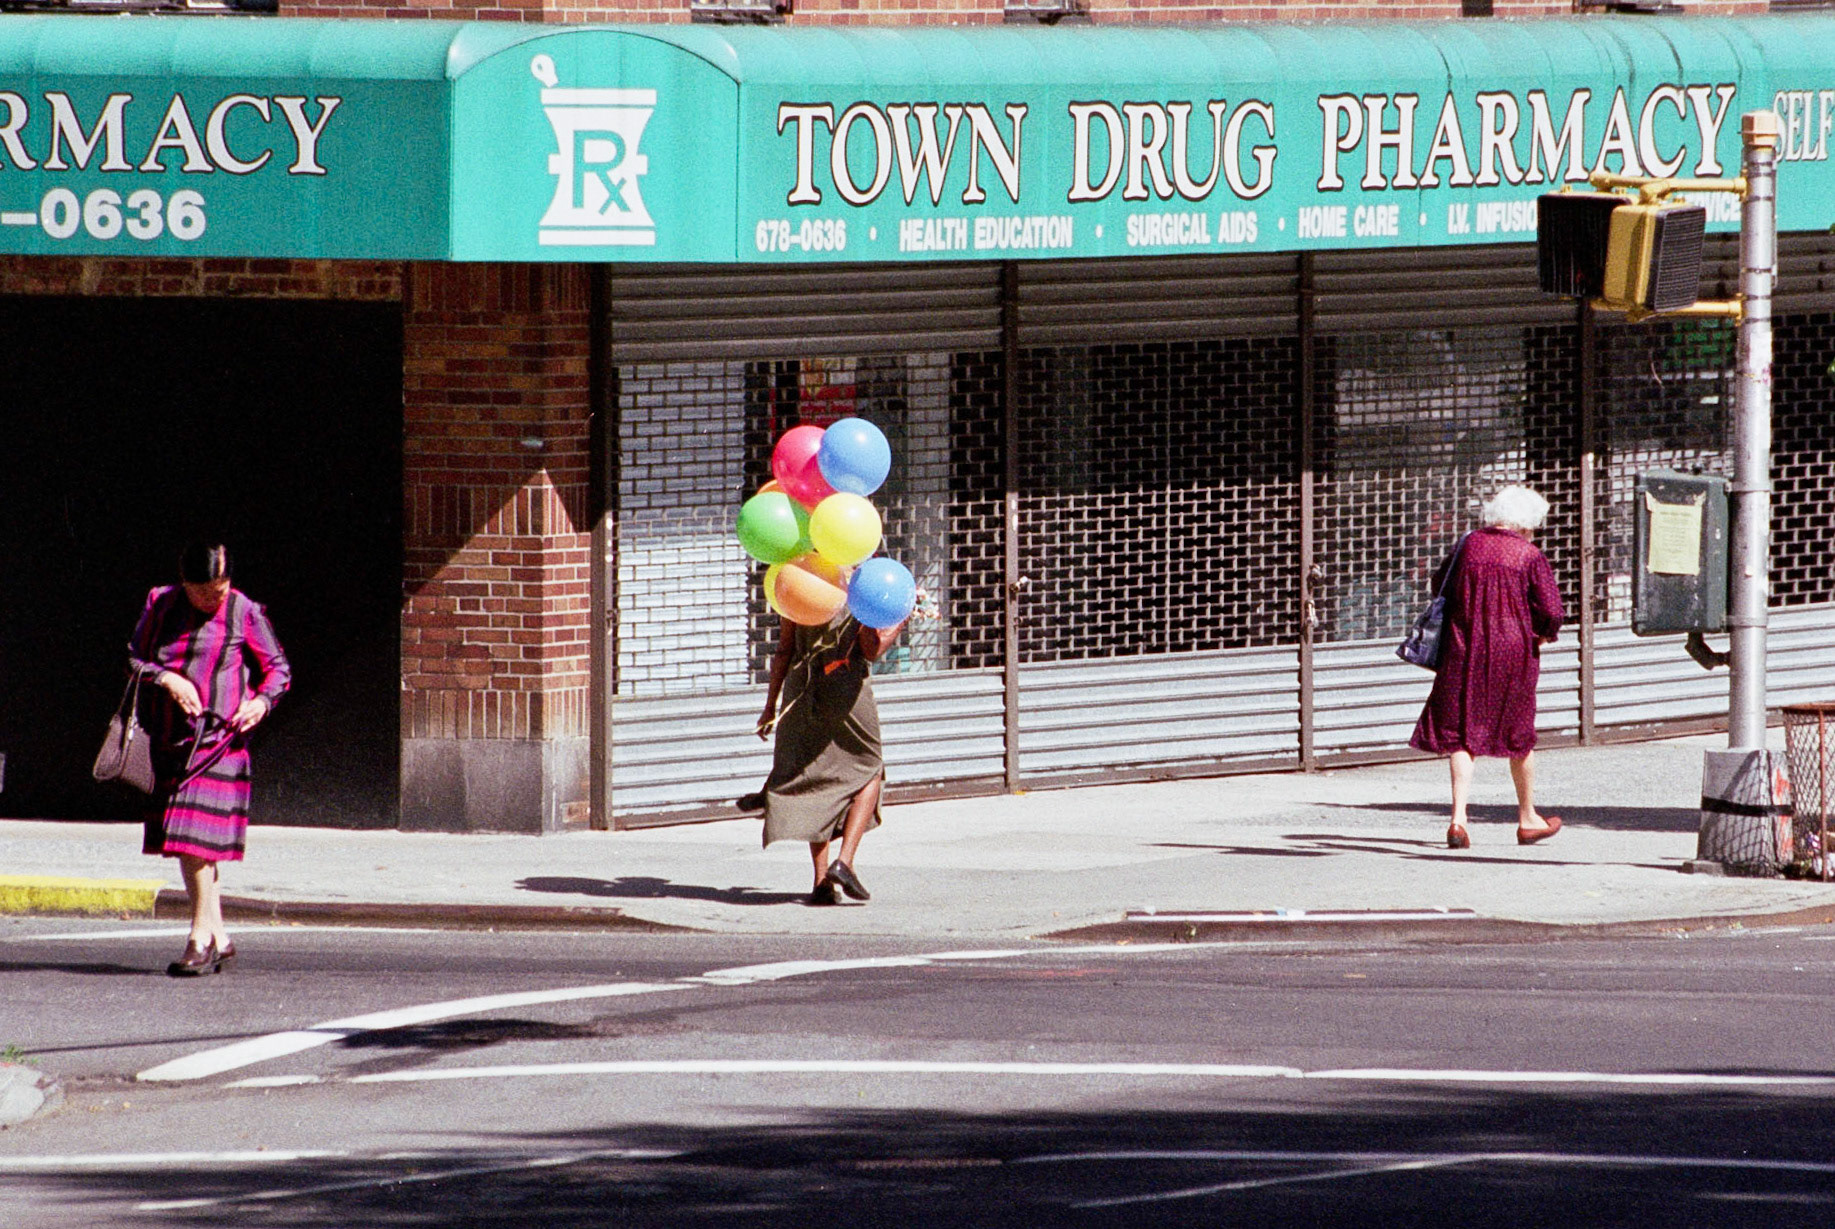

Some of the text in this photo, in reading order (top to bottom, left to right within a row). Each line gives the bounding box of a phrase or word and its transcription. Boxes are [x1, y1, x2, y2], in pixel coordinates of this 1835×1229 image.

[0, 93, 341, 174] RMACY
[778, 83, 1737, 206] TOWN DRUG PHARMACY
[755, 218, 847, 253] 678-0636
[898, 217, 968, 253] HEALTH
[973, 215, 1074, 250] EDUCATION
[1126, 212, 1211, 248] SURGICAL
[1217, 210, 1259, 244] AIDS
[1297, 205, 1348, 239] HOME
[1353, 204, 1400, 237] CARE
[1447, 202, 1471, 235] I.V.
[1475, 199, 1538, 234] INFUSIO
